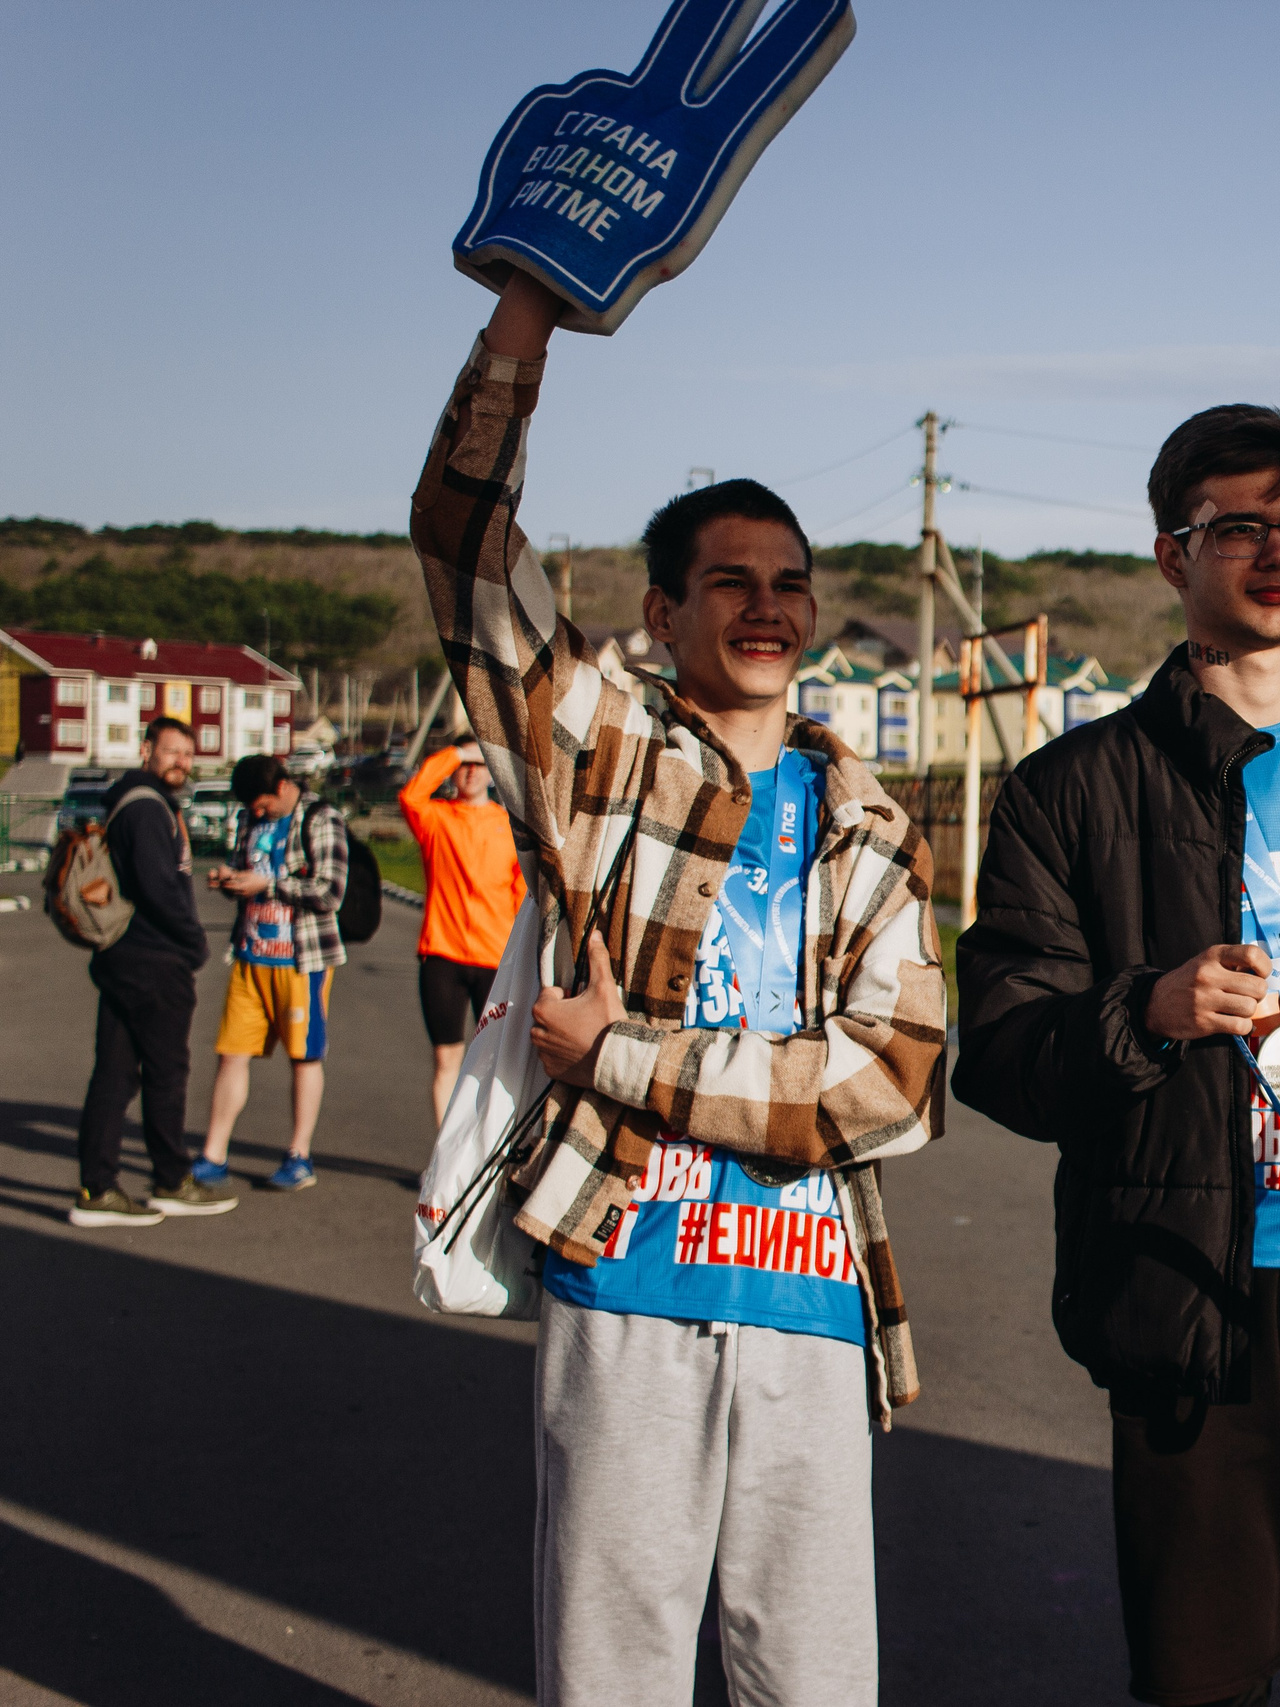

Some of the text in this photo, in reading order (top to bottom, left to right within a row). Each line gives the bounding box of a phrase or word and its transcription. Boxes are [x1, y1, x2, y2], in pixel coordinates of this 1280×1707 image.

[554, 111, 678, 179] СТРАНА
[509, 180, 621, 242] РИТМЕ
[782, 802, 797, 834] ПСБ
[780, 1168, 840, 1216] 20
